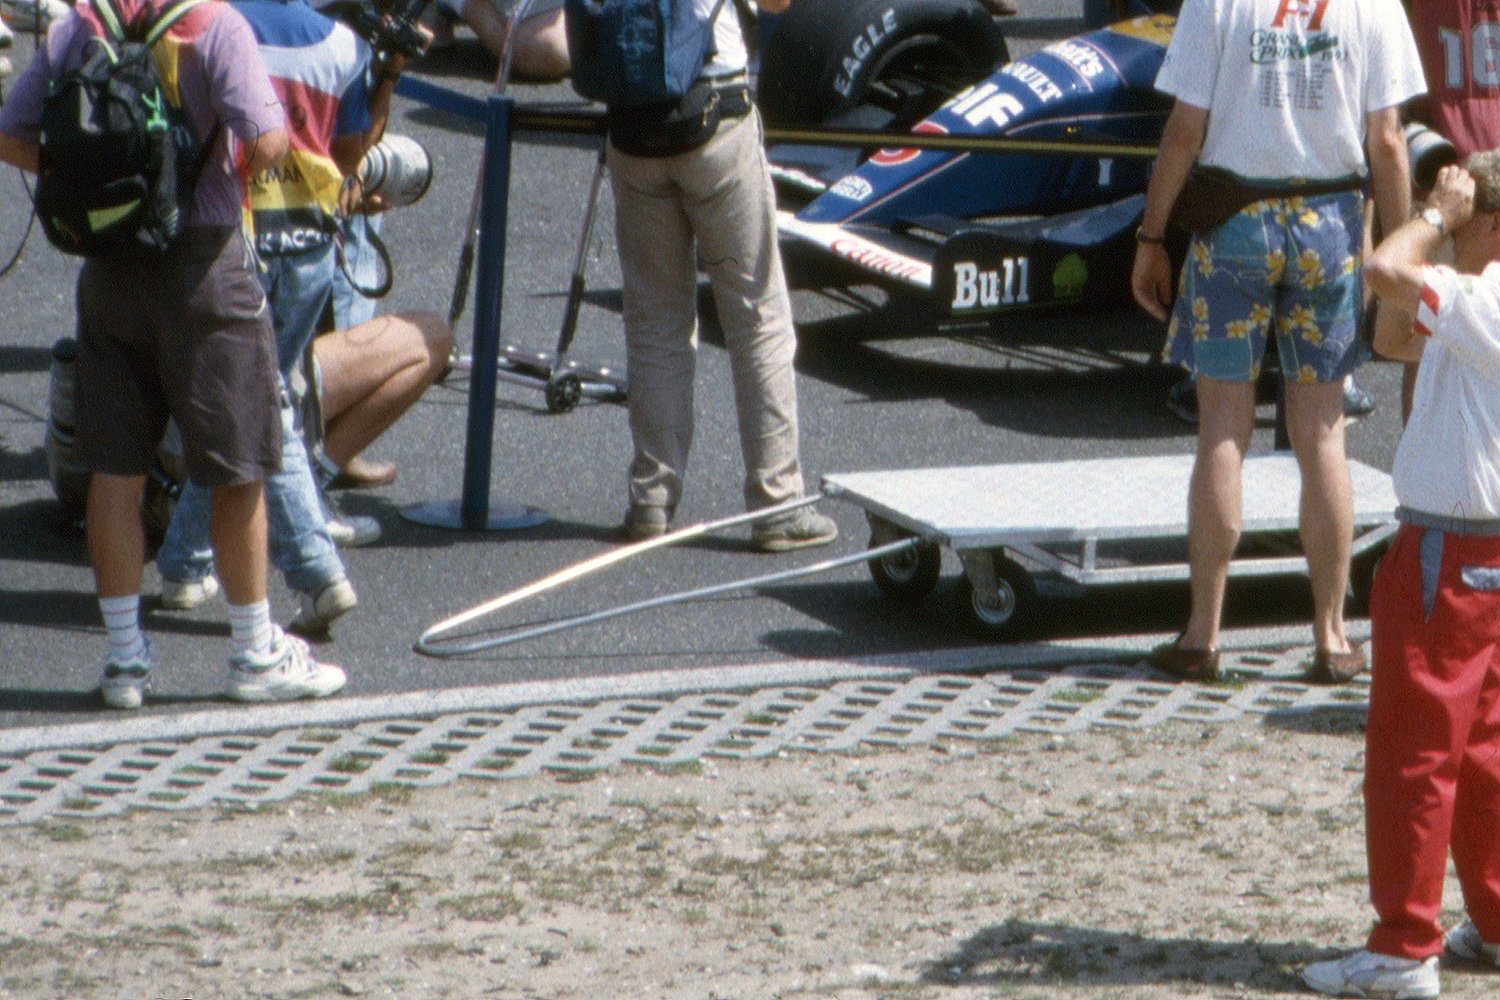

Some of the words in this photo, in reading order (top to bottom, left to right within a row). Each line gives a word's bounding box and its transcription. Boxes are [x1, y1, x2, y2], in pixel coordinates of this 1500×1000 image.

[834, 8, 898, 98] EAGLE
[831, 239, 924, 281] Canon
[951, 254, 1030, 310] Bull
